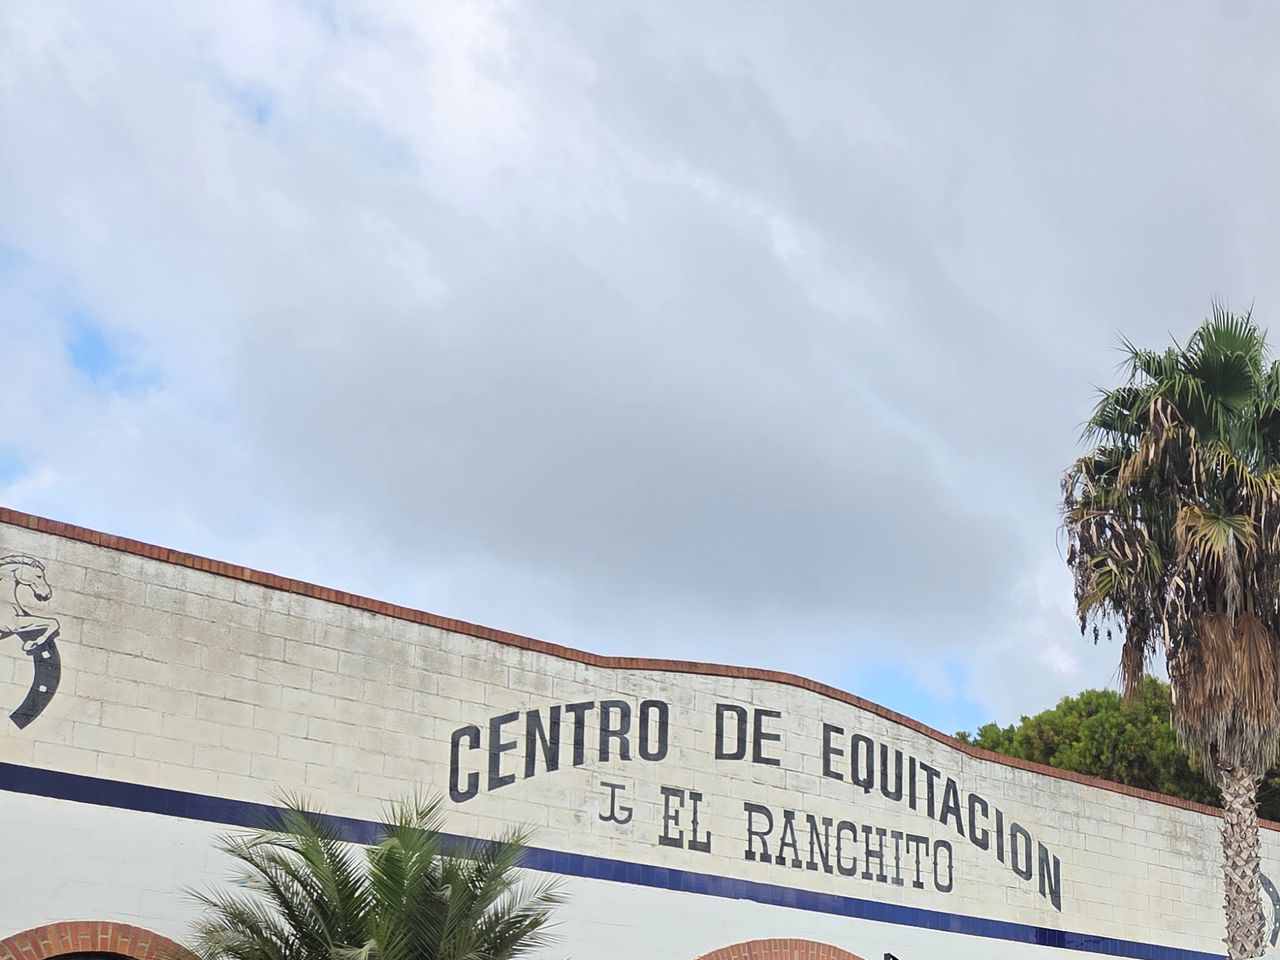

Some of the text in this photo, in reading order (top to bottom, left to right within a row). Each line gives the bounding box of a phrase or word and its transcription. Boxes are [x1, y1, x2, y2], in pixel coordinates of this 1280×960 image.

[449, 699, 1062, 911] CENTRO DE EQUITACION
[658, 786, 954, 893] EL RANCHITO
